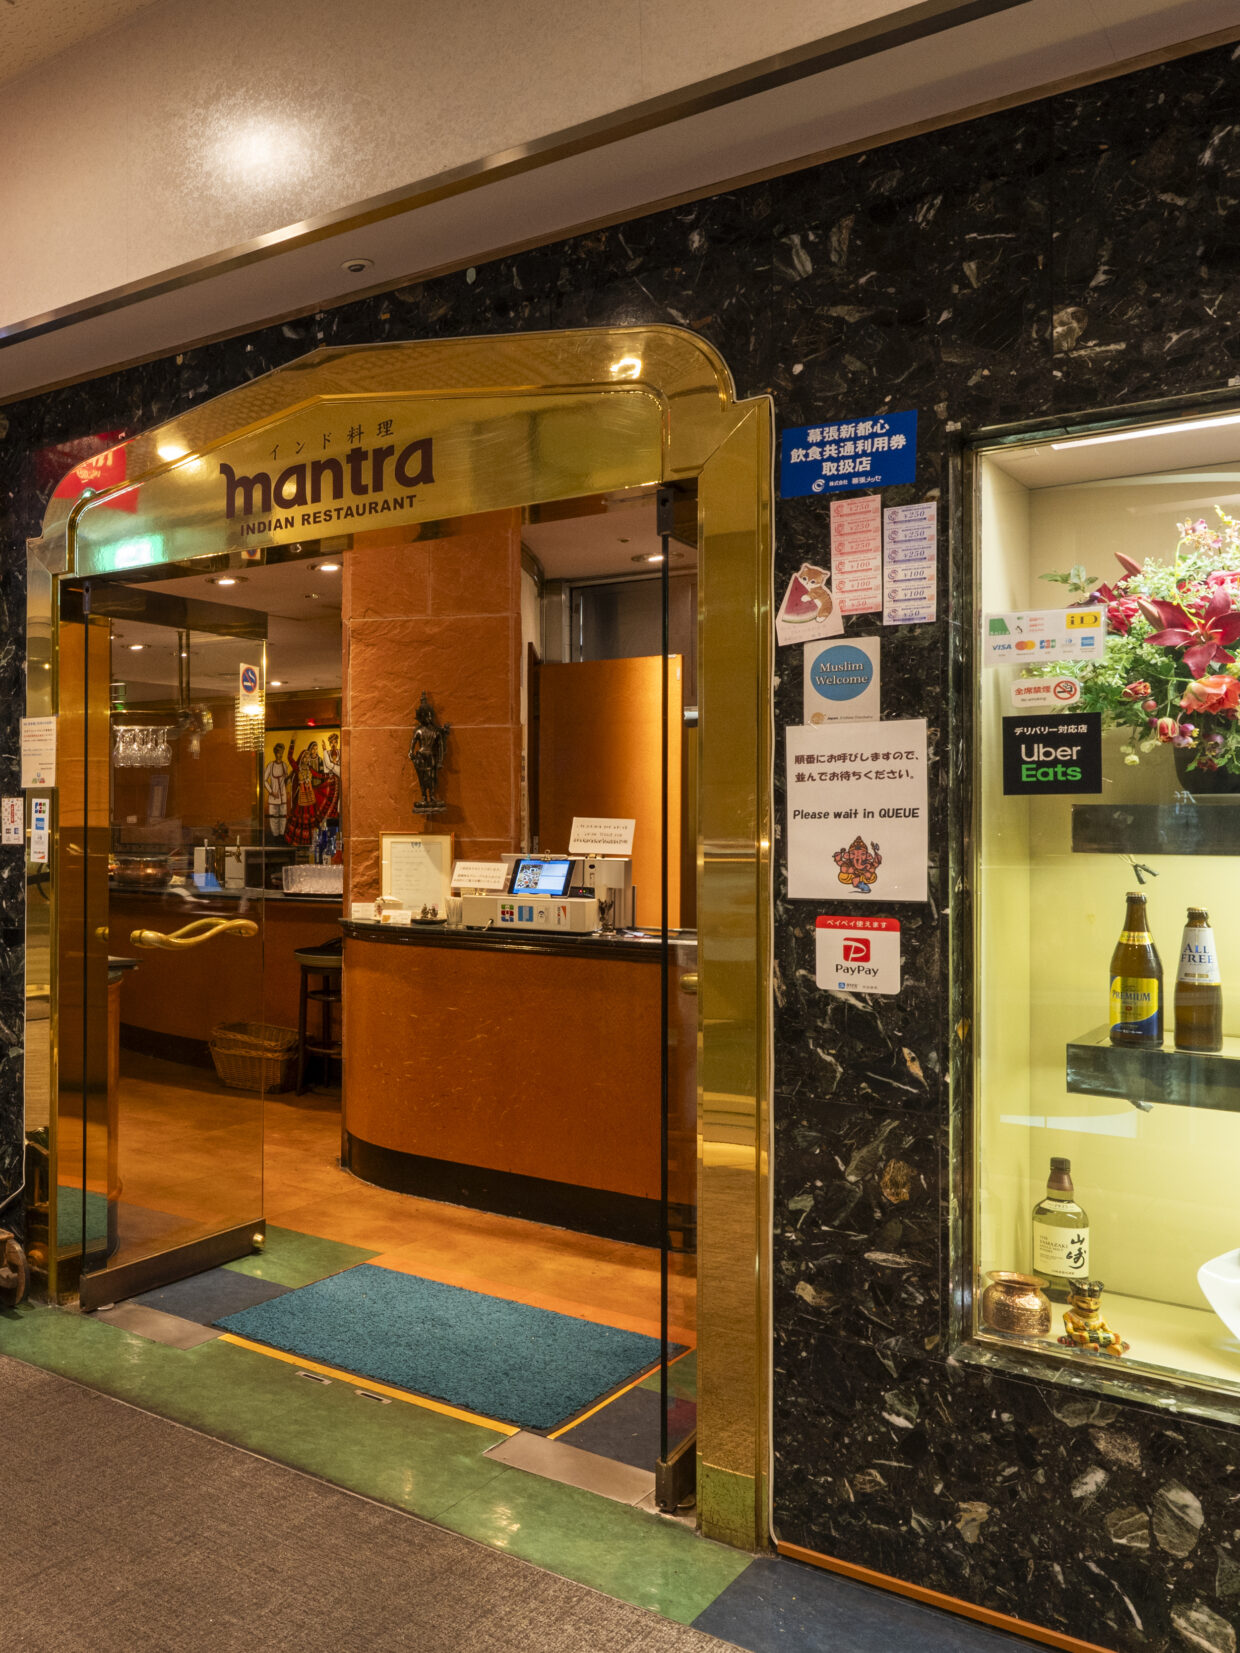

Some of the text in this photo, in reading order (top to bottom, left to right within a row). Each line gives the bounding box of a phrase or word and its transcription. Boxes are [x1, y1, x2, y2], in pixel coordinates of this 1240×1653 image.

[807, 418, 890, 444] 幕張新都心
[270, 419, 393, 461] インド料理
[790, 434, 907, 463] 飲食共通利用券
[822, 456, 872, 476] 取扱店
[219, 437, 435, 519] mantra
[851, 475, 882, 485] 幕張メッセ
[240, 494, 417, 537] INDIAN RESTAURANT
[820, 661, 864, 673] Muslim
[815, 675, 868, 686] Welcome
[1015, 685, 1051, 696] 全席禁煙
[1014, 724, 1088, 736] デリバリー対応店
[794, 750, 919, 764] 順番にお呼びしますので、
[1020, 743, 1081, 761] Uber
[794, 769, 914, 783] 並んでお待ちください。
[1021, 764, 1082, 782] Eats
[793, 807, 920, 819] Please wait in QUEUE
[826, 919, 888, 928] ペイペイ使えます
[1183, 943, 1210, 953] ALL
[1180, 954, 1216, 964] FREE
[835, 963, 879, 977] PayPay
[1112, 990, 1151, 1002] PREMIUM
[1039, 1239, 1069, 1249] YAMAZAKI
[1065, 1233, 1087, 1269] 山崎
